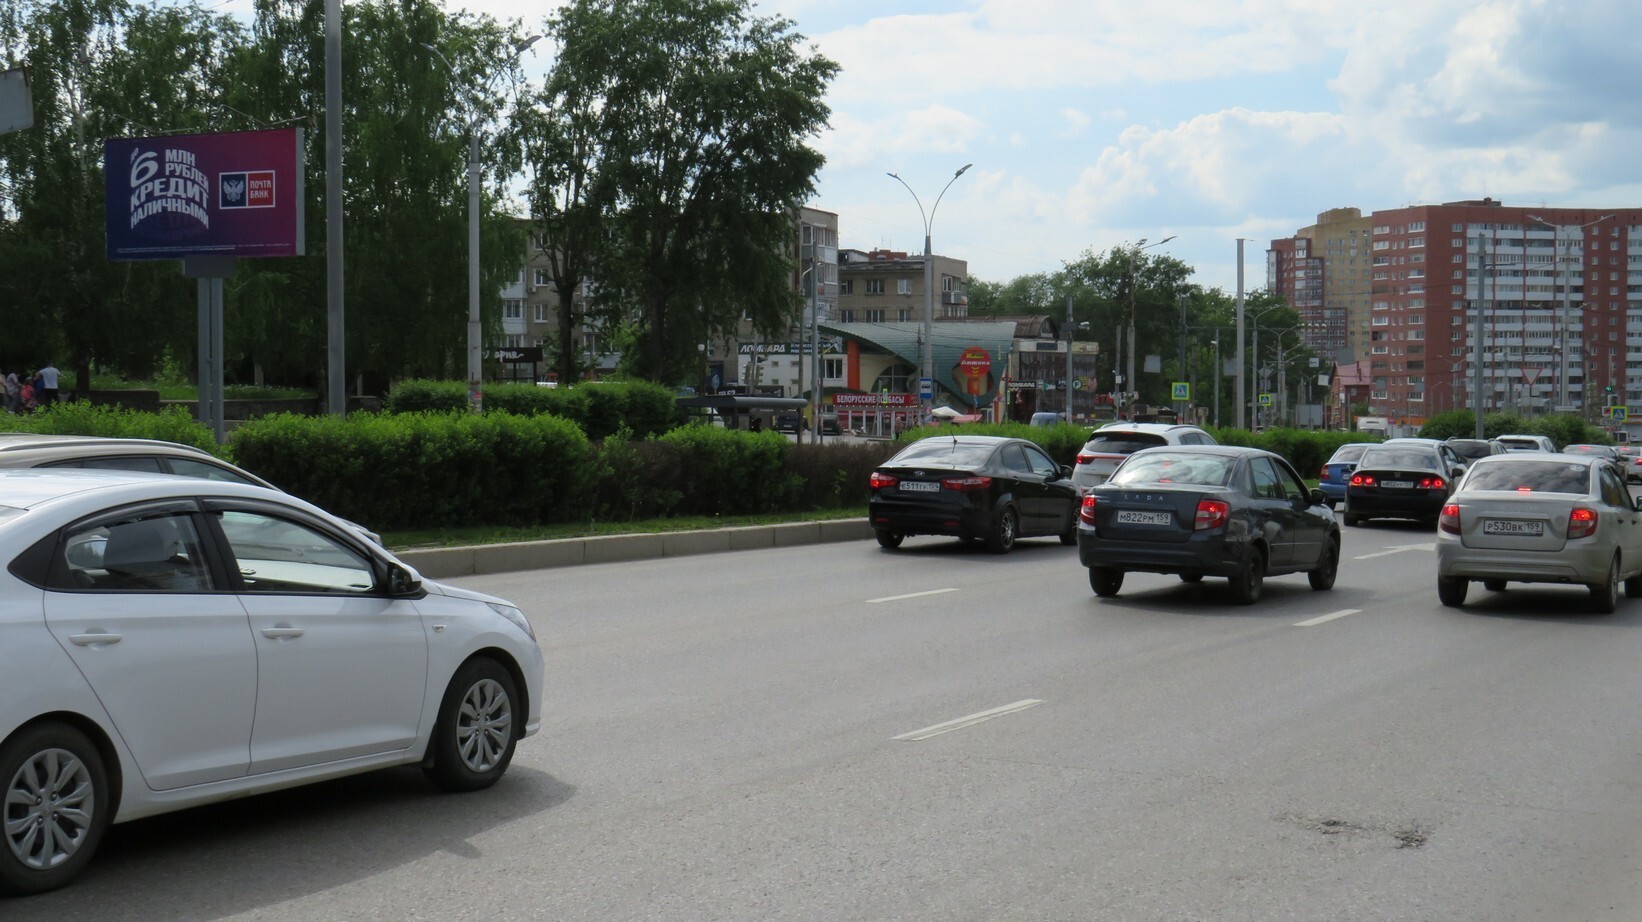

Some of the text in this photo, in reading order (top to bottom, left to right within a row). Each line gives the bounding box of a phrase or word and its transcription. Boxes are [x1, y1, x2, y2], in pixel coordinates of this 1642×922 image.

[131, 149, 195, 188] 6 МЛН
[165, 162, 209, 193] РУБЛЕЙ
[249, 180, 272, 189] ПОЧТА
[130, 177, 209, 213] КРЕДИТ
[249, 190, 269, 199] БАНК
[130, 198, 209, 230] НАЛИЧНЫМИ
[740, 344, 785, 353] ЛОМАРД
[836, 395, 876, 403] БЕЛОРУССКИЕ
[877, 395, 905, 404] ОБАСЫ
[1119, 512, 1169, 523] М822РМ 159
[1487, 521, 1540, 531] Р530ВК 159
